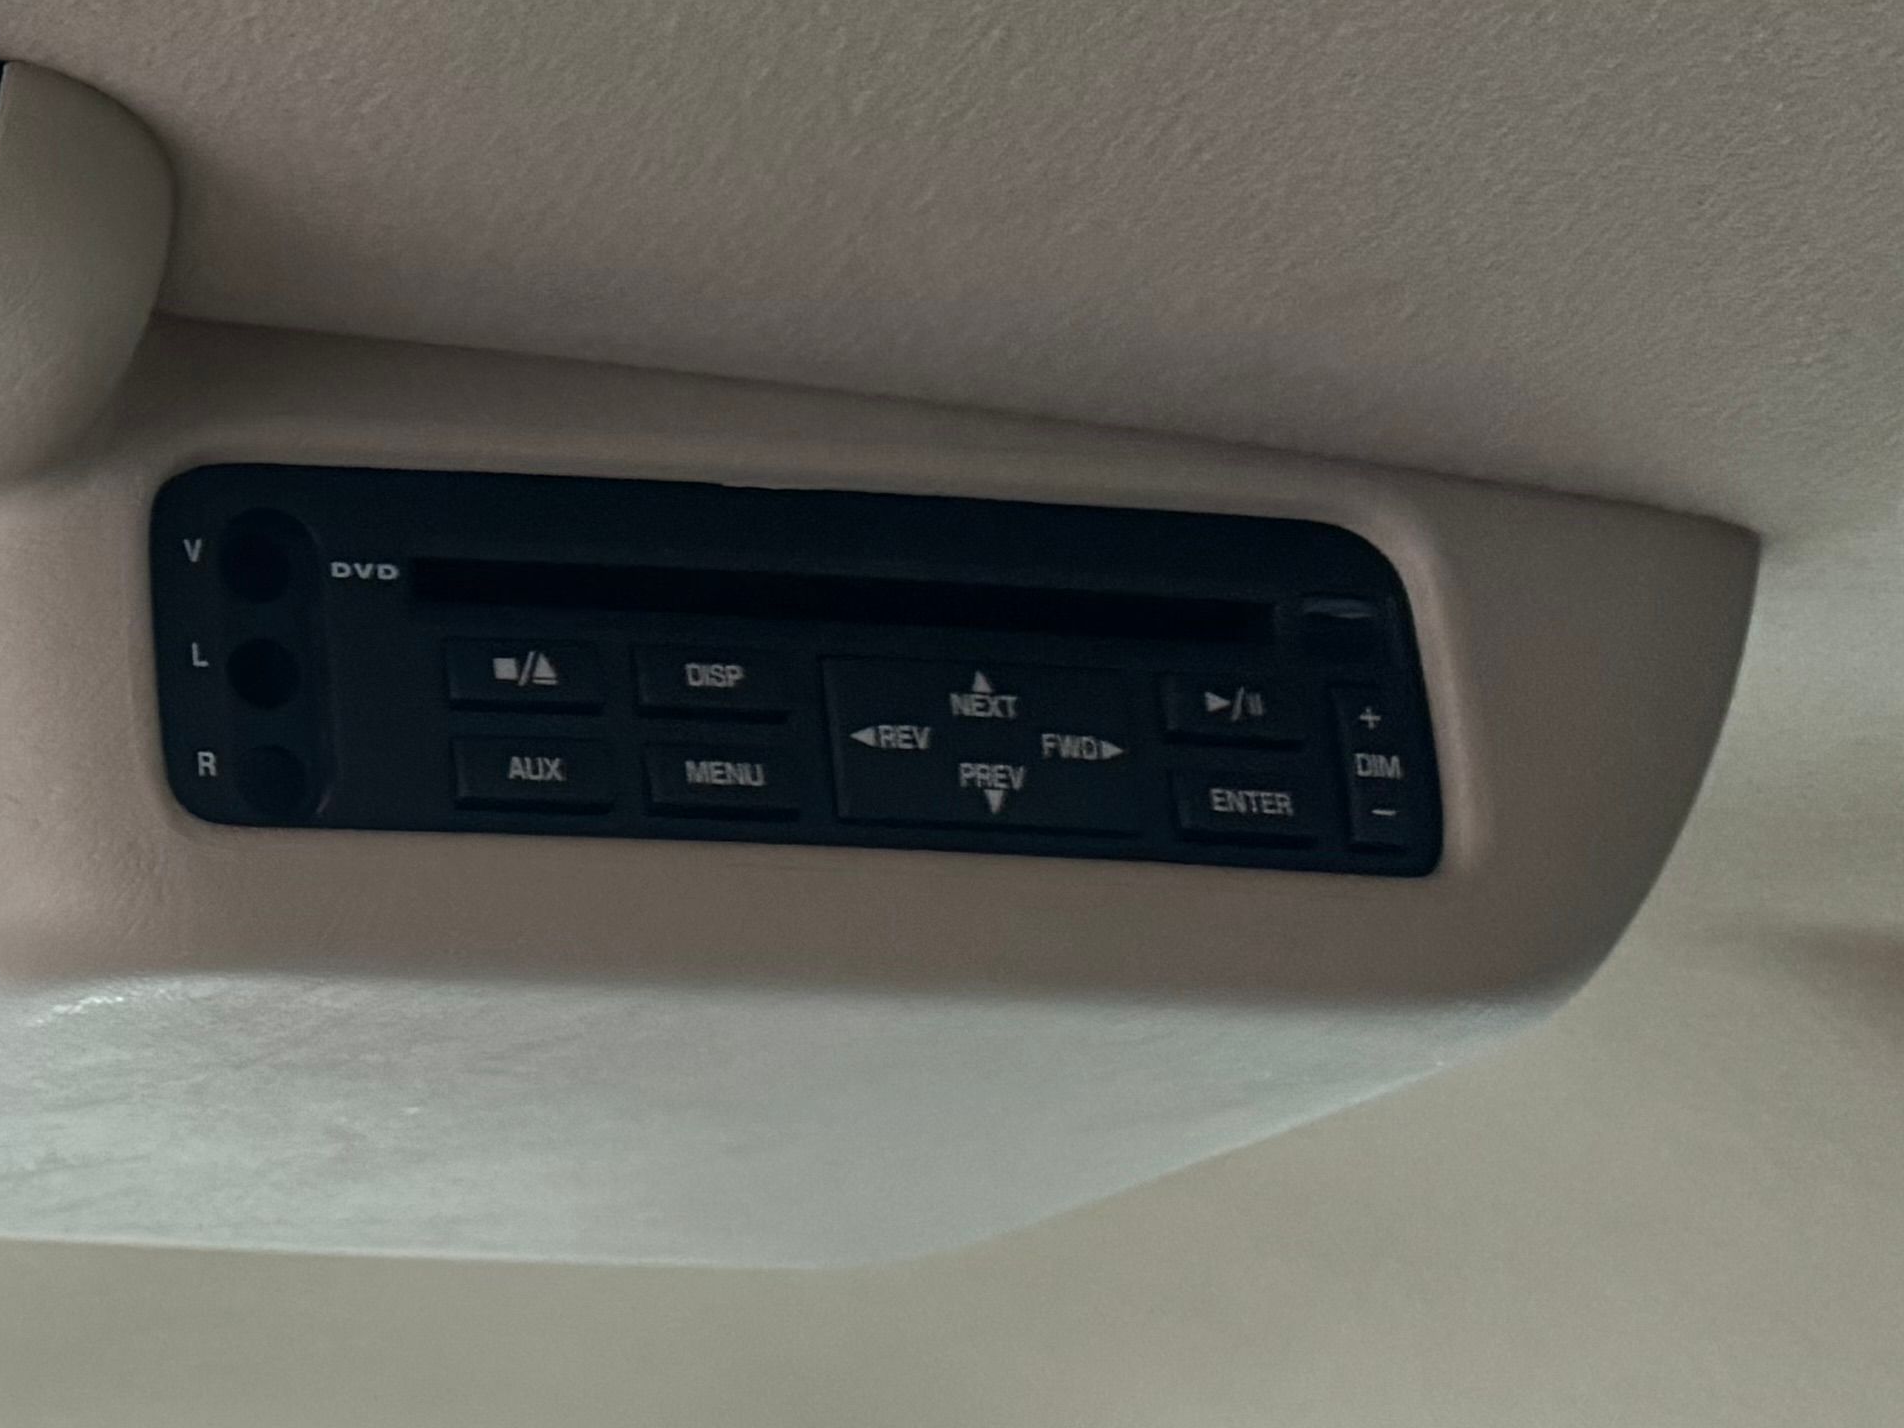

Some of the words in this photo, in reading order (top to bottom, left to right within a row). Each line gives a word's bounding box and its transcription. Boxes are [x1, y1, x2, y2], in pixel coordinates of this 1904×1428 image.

[183, 538, 203, 563] V
[330, 561, 400, 581] DVD
[191, 642, 209, 668] L
[684, 662, 745, 688] DISP
[949, 693, 1020, 719] NEXT
[878, 724, 931, 750] REV
[1041, 733, 1097, 761] FWD
[197, 751, 217, 777] R
[508, 755, 564, 782] AUX
[684, 760, 766, 787] MENU
[958, 762, 1026, 789] PREV
[1354, 752, 1403, 779] DIM
[1210, 787, 1294, 816] ENTER
